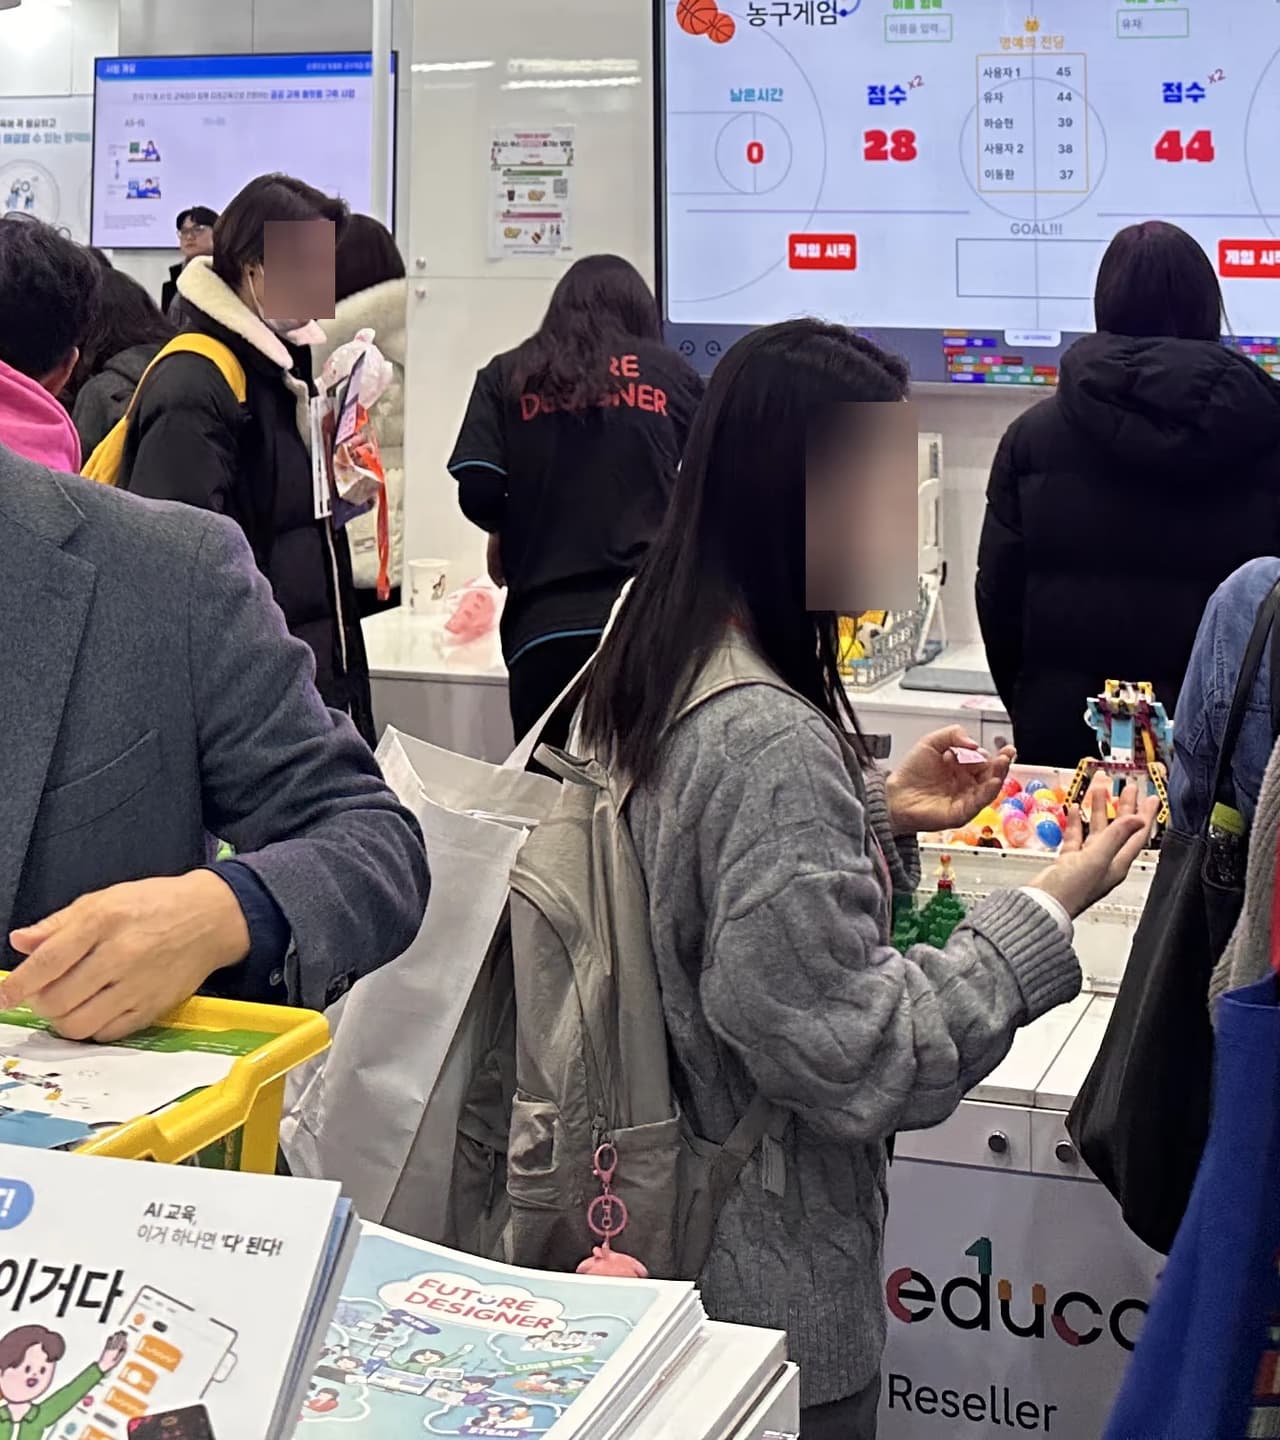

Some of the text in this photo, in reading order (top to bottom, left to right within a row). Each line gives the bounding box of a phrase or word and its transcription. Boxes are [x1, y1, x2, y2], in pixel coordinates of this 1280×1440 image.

[746, 0, 838, 27] 농구게임
[982, 66, 1012, 78] 사용자
[1056, 67, 1072, 77] 45
[867, 85, 908, 106] 점수
[1056, 92, 1073, 102] 44
[1162, 81, 1206, 104] 점수
[1057, 117, 1073, 128] 39
[746, 141, 764, 164] 0
[863, 129, 917, 161] 28
[984, 143, 1073, 155] 사용자 2 38
[1154, 130, 1215, 162] 44
[1059, 169, 1074, 180] 37
[1010, 222, 1063, 236] GOAL!!!
[794, 242, 852, 259] 게임 시작
[1225, 249, 1255, 266] 게임
[143, 1201, 197, 1226] AI 교육,
[137, 1223, 169, 1245] 이거
[171, 1227, 218, 1251] 하나면
[245, 1236, 284, 1258] 된다!
[403, 1290, 556, 1332] DESIGNER
[887, 1373, 1058, 1432] Reseller
